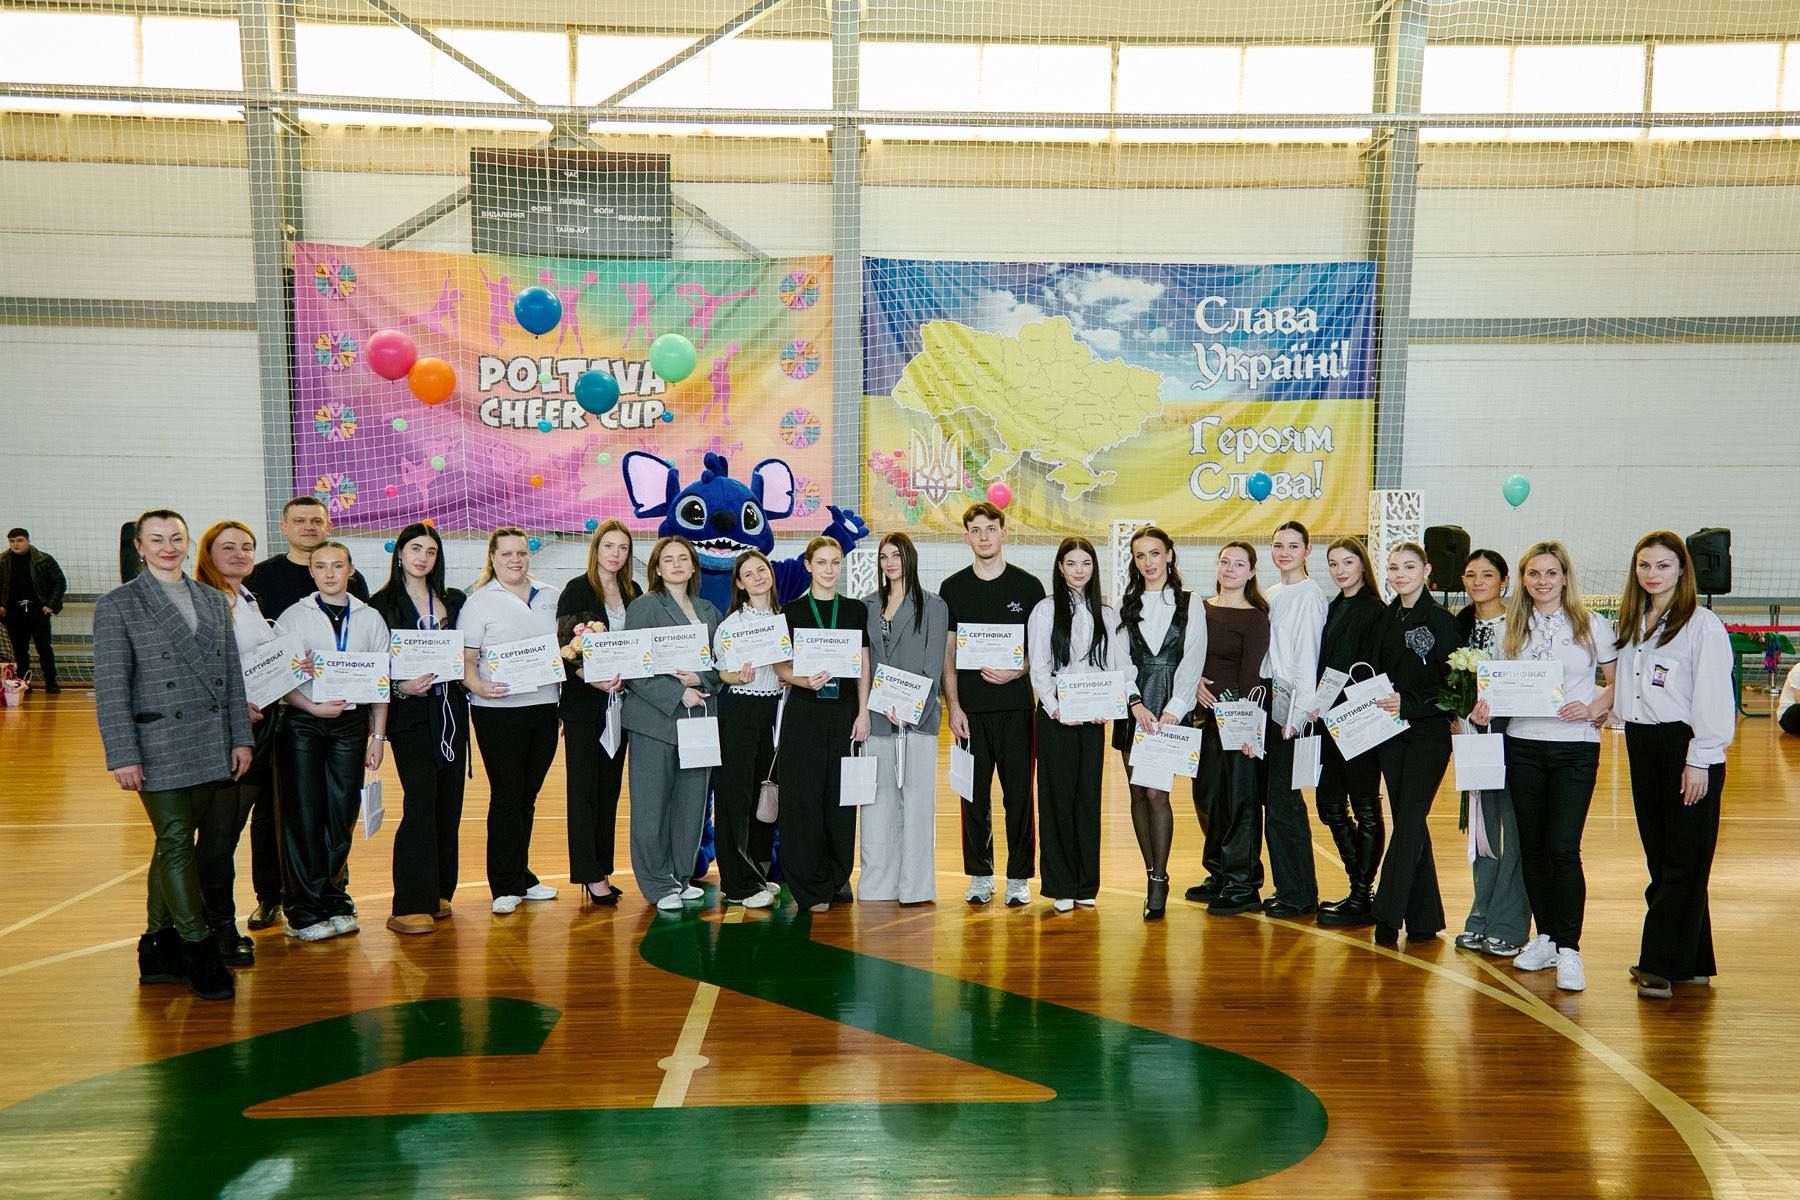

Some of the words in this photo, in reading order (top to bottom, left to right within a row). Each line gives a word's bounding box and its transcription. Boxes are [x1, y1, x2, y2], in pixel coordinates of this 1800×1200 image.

[559, 198, 586, 206] ПЕРІОД
[1195, 295, 1319, 335] Слава
[1191, 339, 1350, 390] Україні!
[480, 396, 589, 429] CHEER
[1189, 415, 1335, 464] Героям
[1189, 460, 1324, 502] Слва!
[654, 633, 697, 643] СЕРТИФІКАТ
[732, 625, 775, 638] СЕРТИФІКАТ
[594, 638, 639, 648] СЕРТИФІКАТ
[806, 637, 850, 645] СЕРТИФІКАТ
[500, 645, 547, 659] СЕРТИФІКАТ
[244, 649, 285, 677] СЕРТИФІКАТ
[327, 660, 375, 668] СЕРТИФІКАТ
[885, 675, 922, 691] СЕРТИФІКАТ
[1069, 680, 1113, 689] СЕРТИФІКАТ
[1336, 697, 1378, 724] СЕРТИФІКАТ
